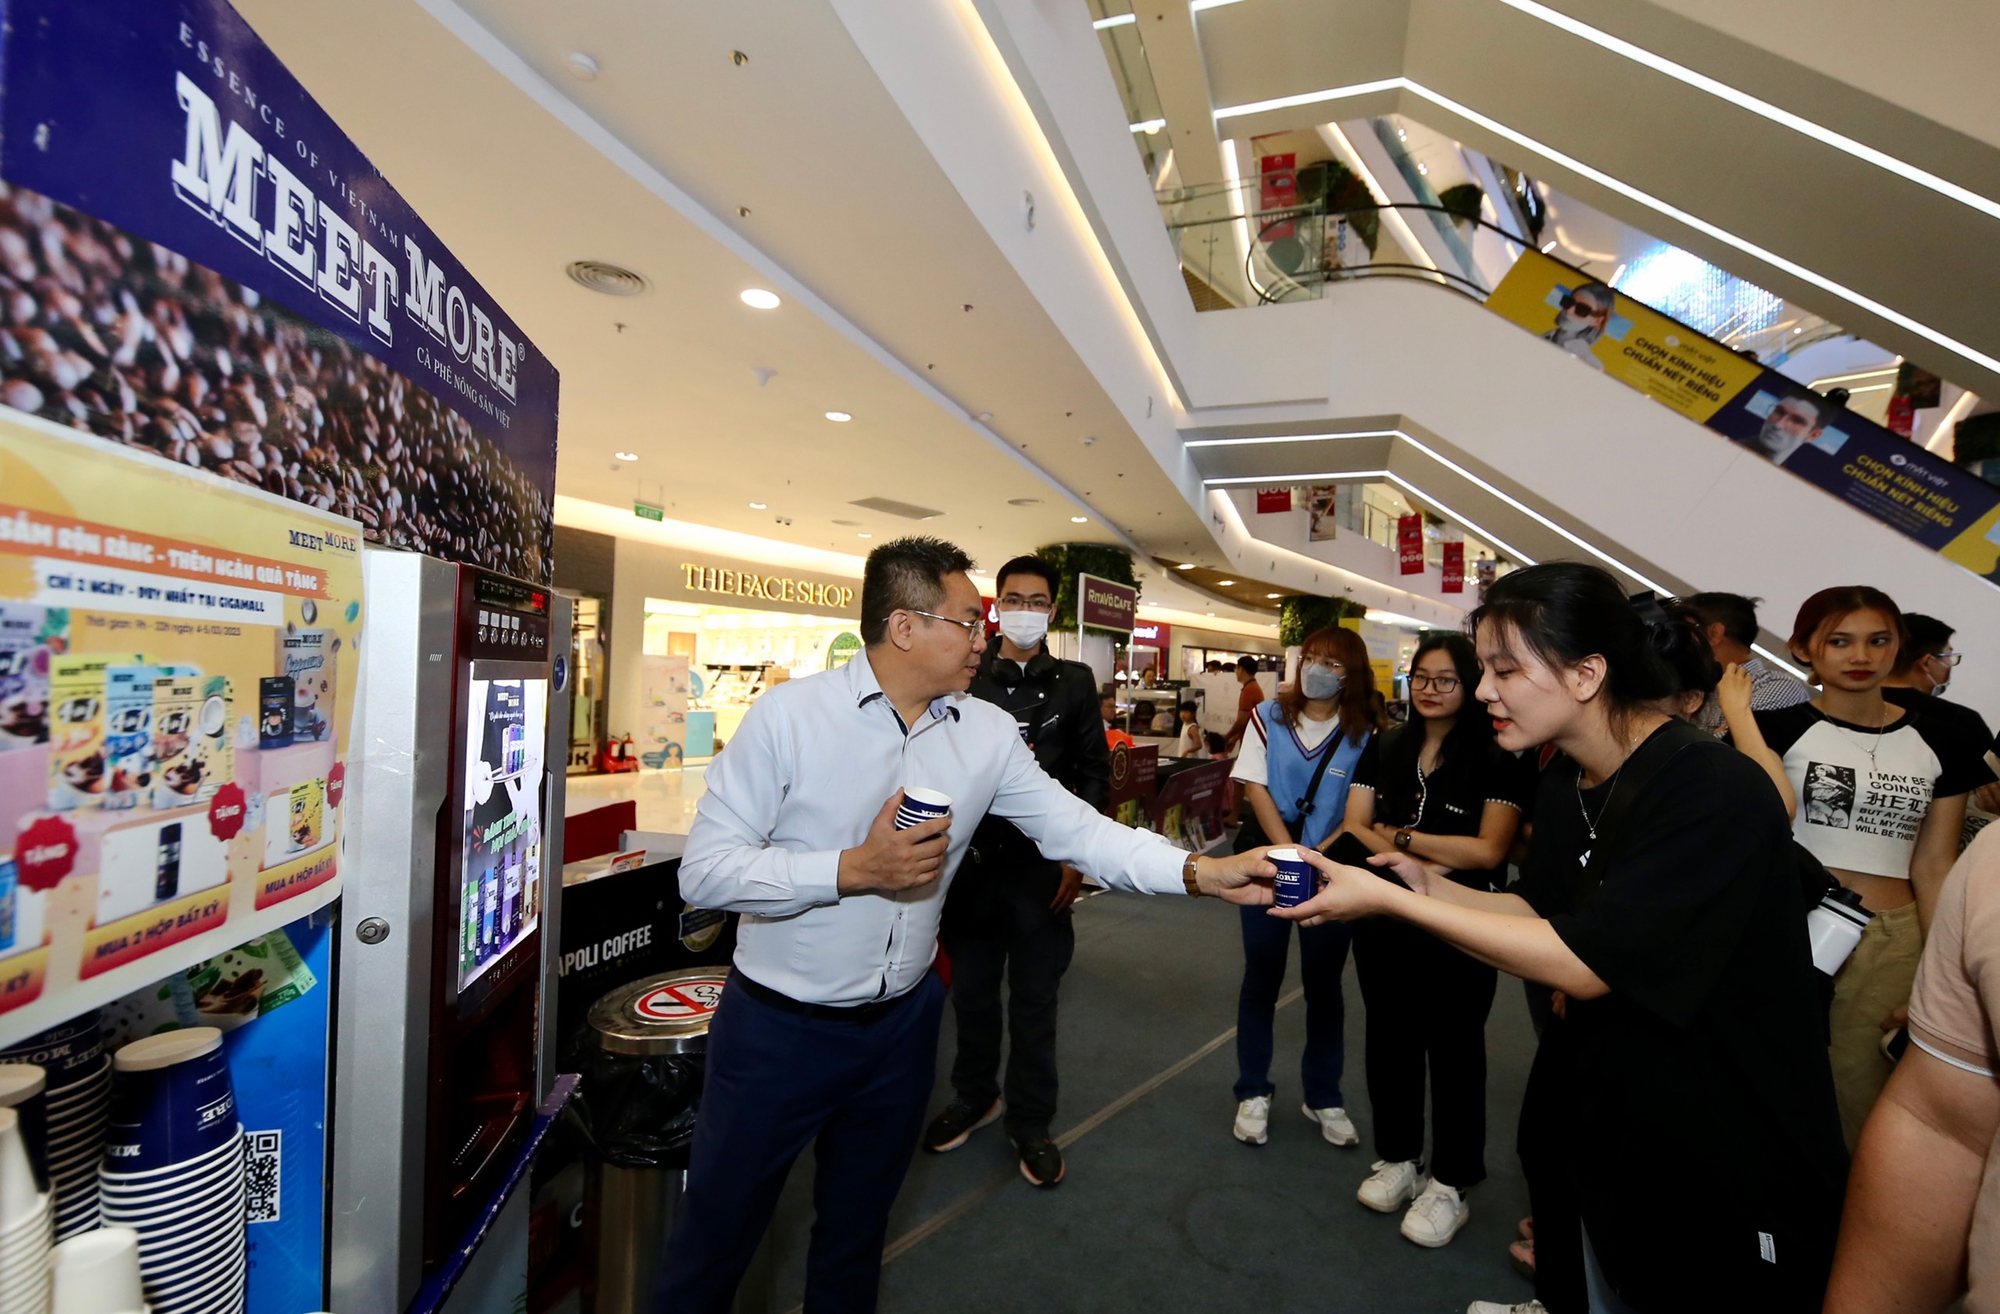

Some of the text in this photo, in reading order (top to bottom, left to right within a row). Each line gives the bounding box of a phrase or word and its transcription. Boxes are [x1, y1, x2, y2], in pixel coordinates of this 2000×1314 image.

[179, 21, 398, 247] ESSENCE OF VIETNAM
[171, 71, 398, 348] MEET
[1623, 346, 1662, 372] CHUẨN
[1663, 366, 1687, 384] NÉT
[1686, 379, 1721, 402] RIÊNG
[1635, 338, 1669, 359] CHỌN
[1669, 354, 1697, 374] KÍNH
[1697, 368, 1726, 389] HIỆU
[416, 347, 511, 429] CÀ PHÊ NÔNG SẢN VIỆT
[1842, 464, 1889, 492] CHUẨN
[1887, 487, 1915, 505] NÉT
[1913, 501, 1953, 527] RIÊNG
[1856, 455, 1895, 479] CHỌN
[1894, 474, 1928, 496] KÍNH
[1926, 491, 1959, 513] HIỆU
[289, 529, 323, 552] MEET
[325, 530, 357, 552] MORE
[168, 549, 214, 573] THÊM
[256, 566, 284, 585] QUÀ
[285, 571, 318, 591] TẶNG
[680, 562, 855, 608] THE FACE SHOP
[219, 598, 265, 613] GIGAMALL
[1868, 772, 1927, 787] I MAY BE
[1870, 781, 1920, 796] GOING
[214, 803, 241, 823] TẶNG
[1855, 824, 1879, 835] WILL
[1881, 828, 1895, 838] BE
[1856, 815, 1877, 825] ALL
[1879, 819, 1896, 828] MY
[1859, 807, 1883, 817] BUT
[1883, 811, 1900, 820] AT
[264, 877, 286, 895] MUA
[288, 875, 295, 887] 4
[297, 867, 313, 884] HỘP
[95, 936, 128, 959] MUA
[133, 931, 142, 946] 2
[146, 917, 174, 939] HỘP
[176, 903, 201, 928] BẤT
[558, 924, 653, 978] APOLI COFFEE
